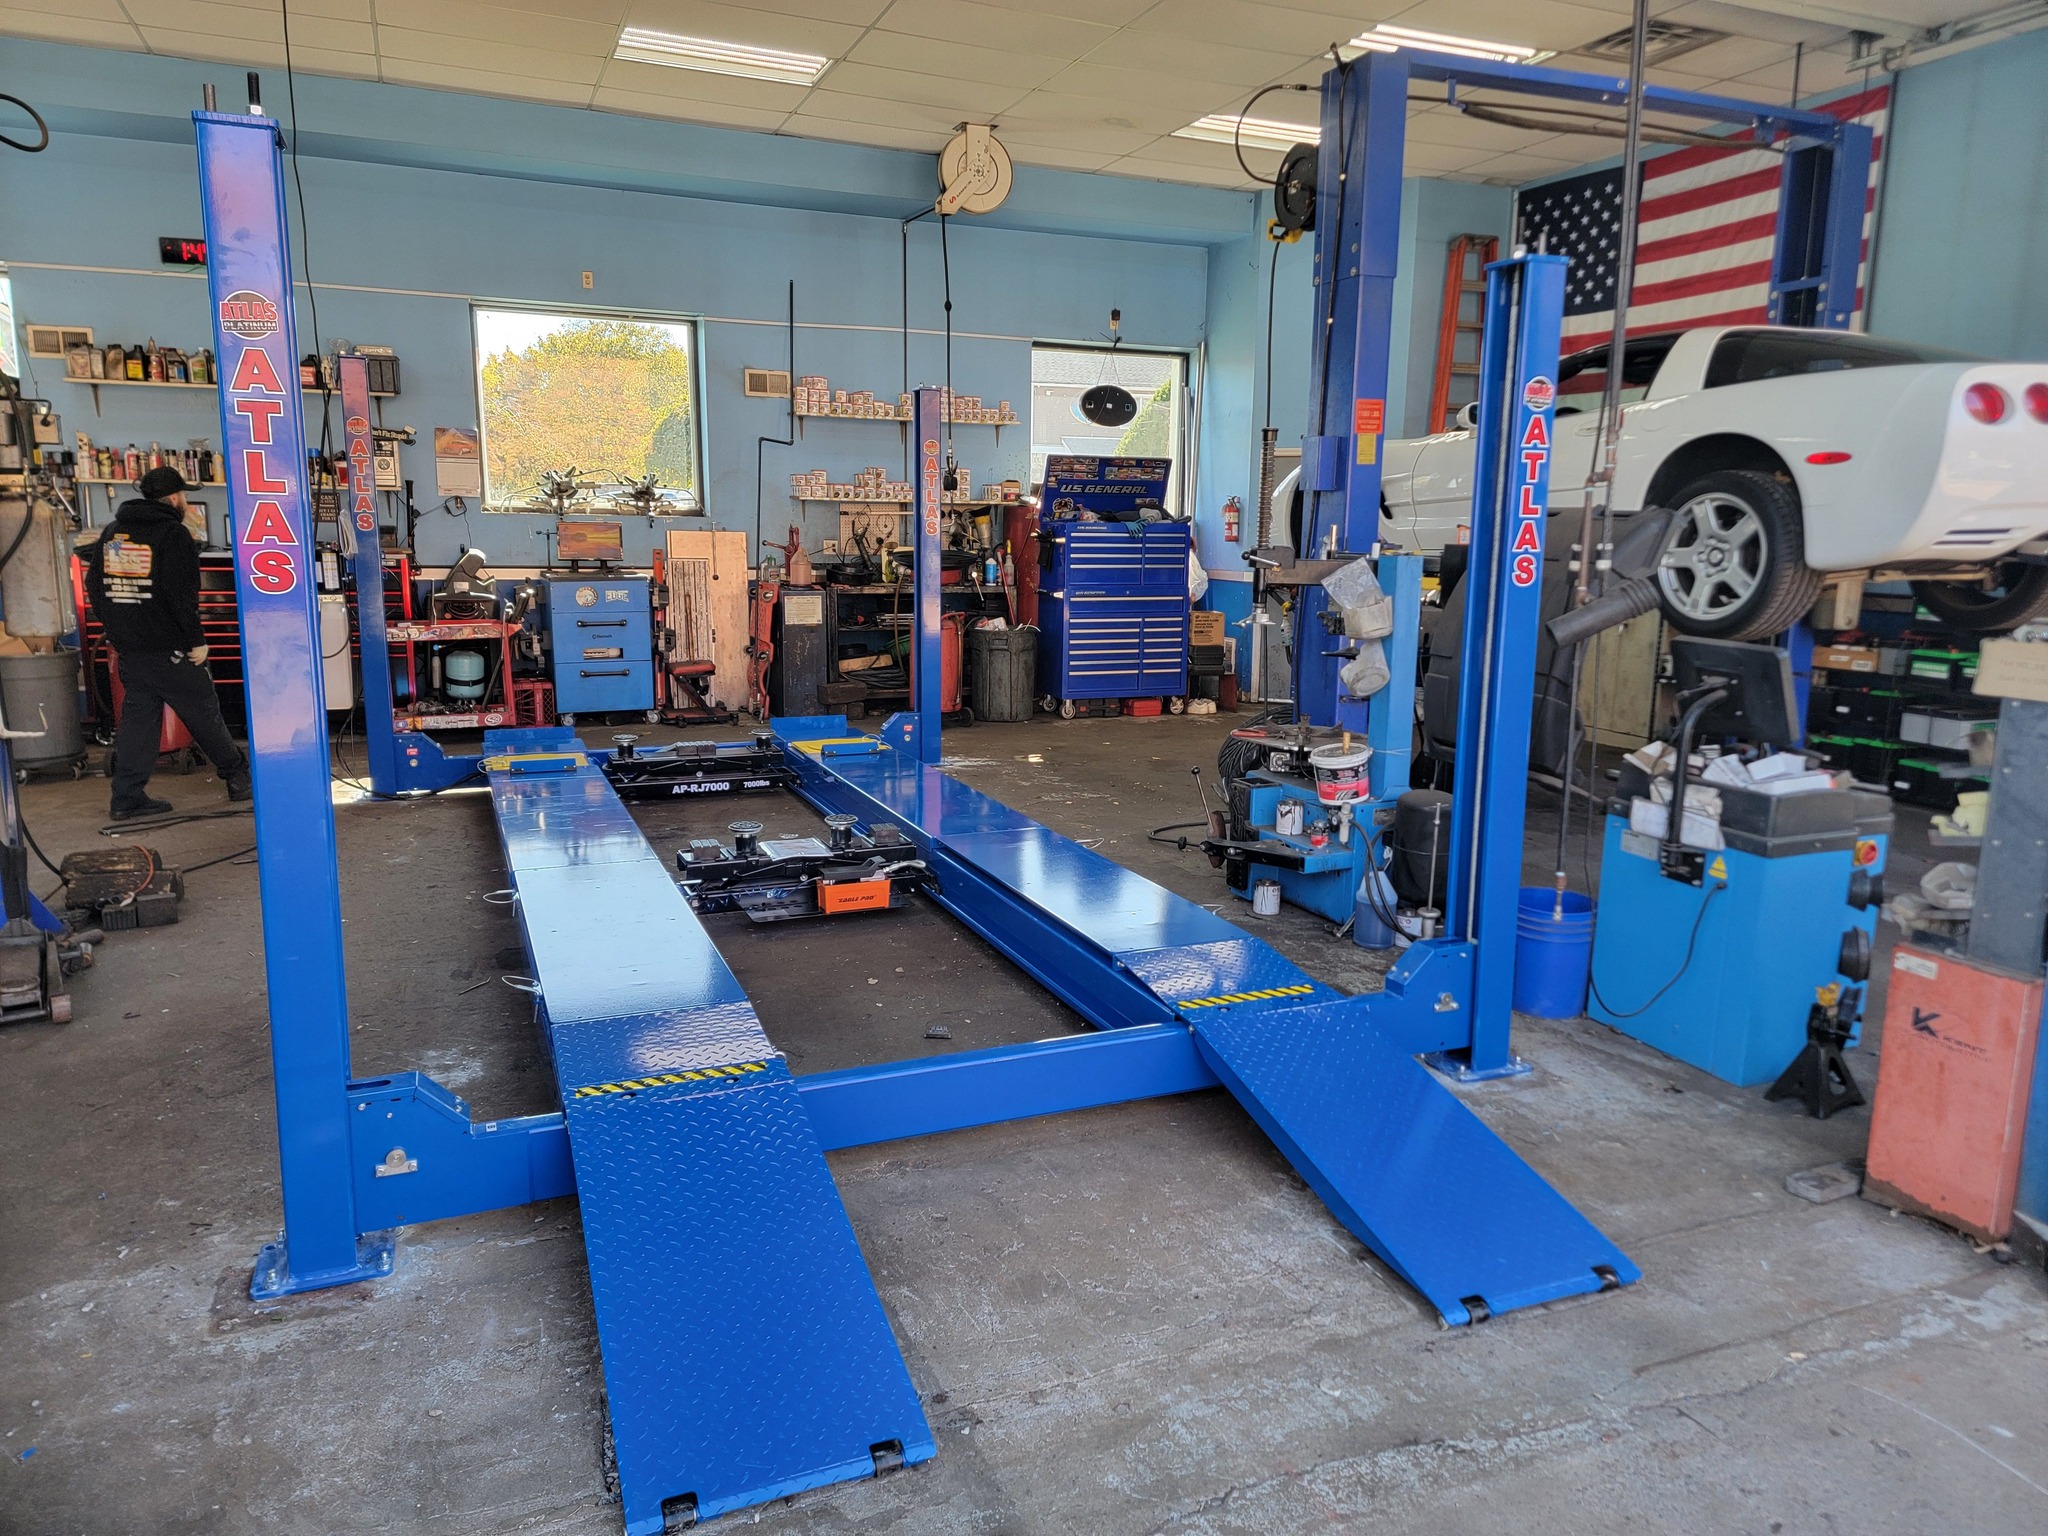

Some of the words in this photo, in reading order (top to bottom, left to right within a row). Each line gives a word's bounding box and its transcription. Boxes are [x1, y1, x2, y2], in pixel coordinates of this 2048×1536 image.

[220, 301, 278, 321] ATLAS
[223, 321, 278, 331] PLATINUM
[229, 346, 299, 595] ATLAS
[349, 438, 375, 531] ATLAS
[1084, 485, 1148, 494] GENERAL
[924, 456, 939, 536] ATLAS
[1511, 413, 1549, 588] ATLAS
[605, 590, 629, 603] EDGE
[672, 782, 730, 794] AP-RJ7000
[743, 780, 770, 788] 7000lbs
